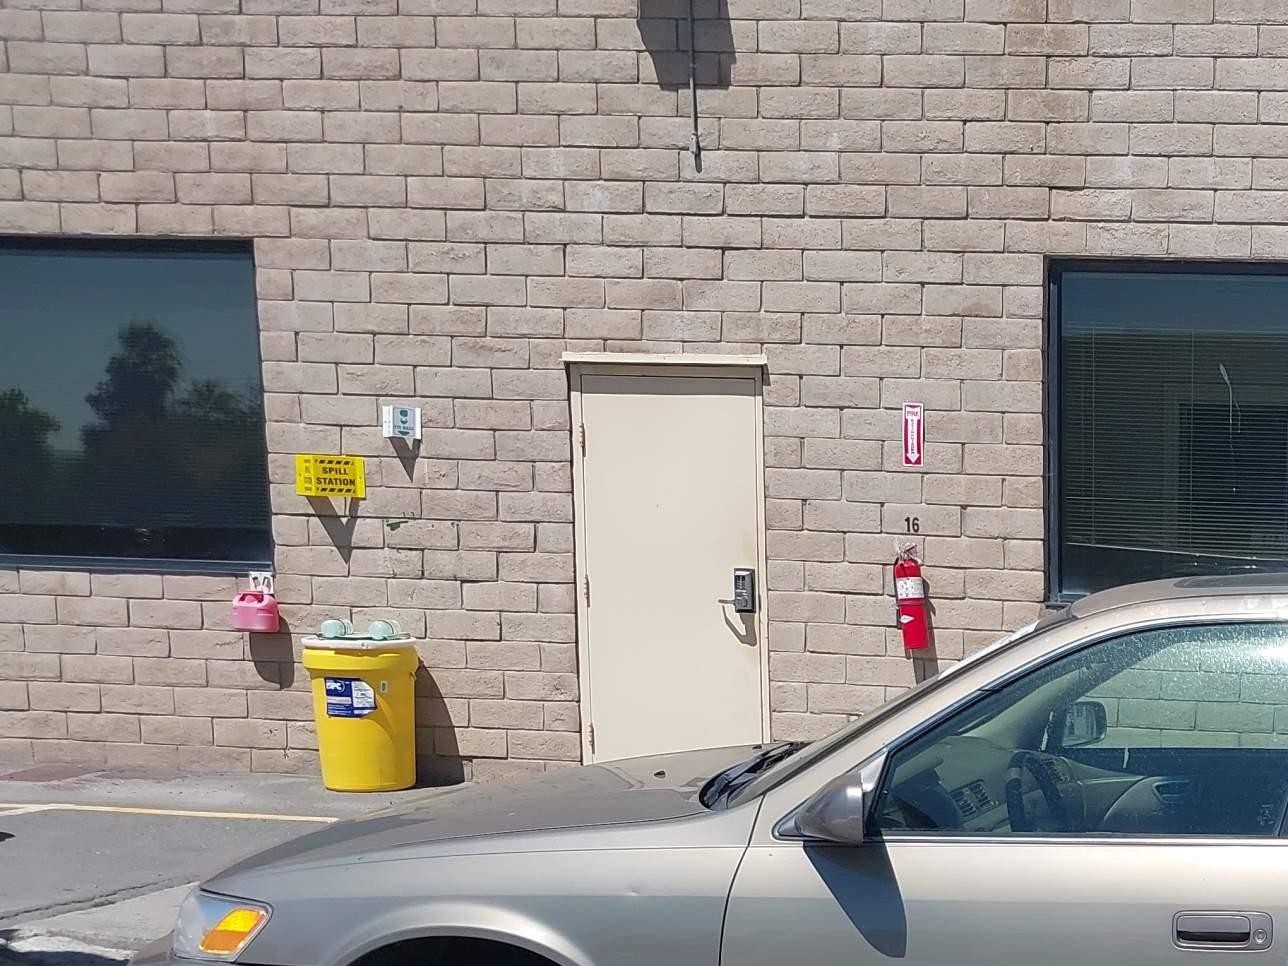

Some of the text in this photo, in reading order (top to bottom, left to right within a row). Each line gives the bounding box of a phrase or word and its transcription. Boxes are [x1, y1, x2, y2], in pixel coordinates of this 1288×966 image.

[322, 467, 349, 475] SPILL
[316, 477, 356, 486] STATION
[904, 516, 920, 533] 16
